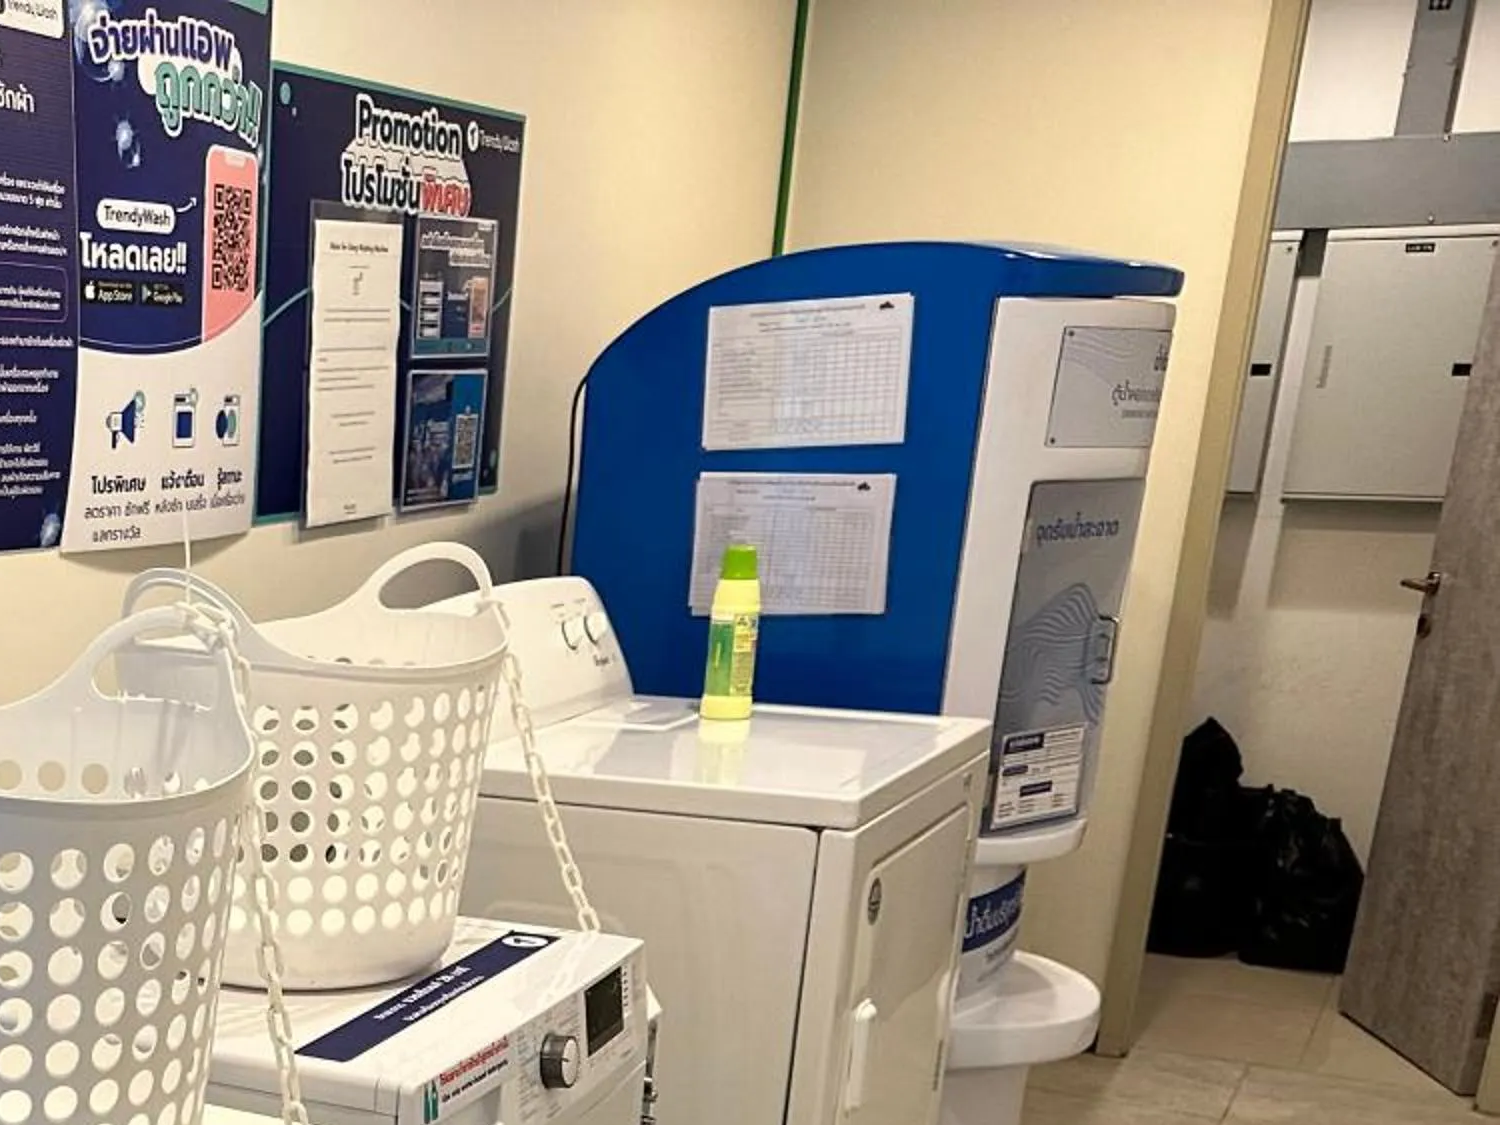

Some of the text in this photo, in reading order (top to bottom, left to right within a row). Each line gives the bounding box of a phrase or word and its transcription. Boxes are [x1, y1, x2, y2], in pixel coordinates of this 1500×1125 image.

[89, 11, 234, 72] จ่ายผ่านแอพ
[357, 96, 461, 158] Promotion
[104, 205, 170, 226] TrendyWash
[80, 232, 187, 275] โหลดเลย!!
[92, 475, 146, 494] โปรพิเศษ
